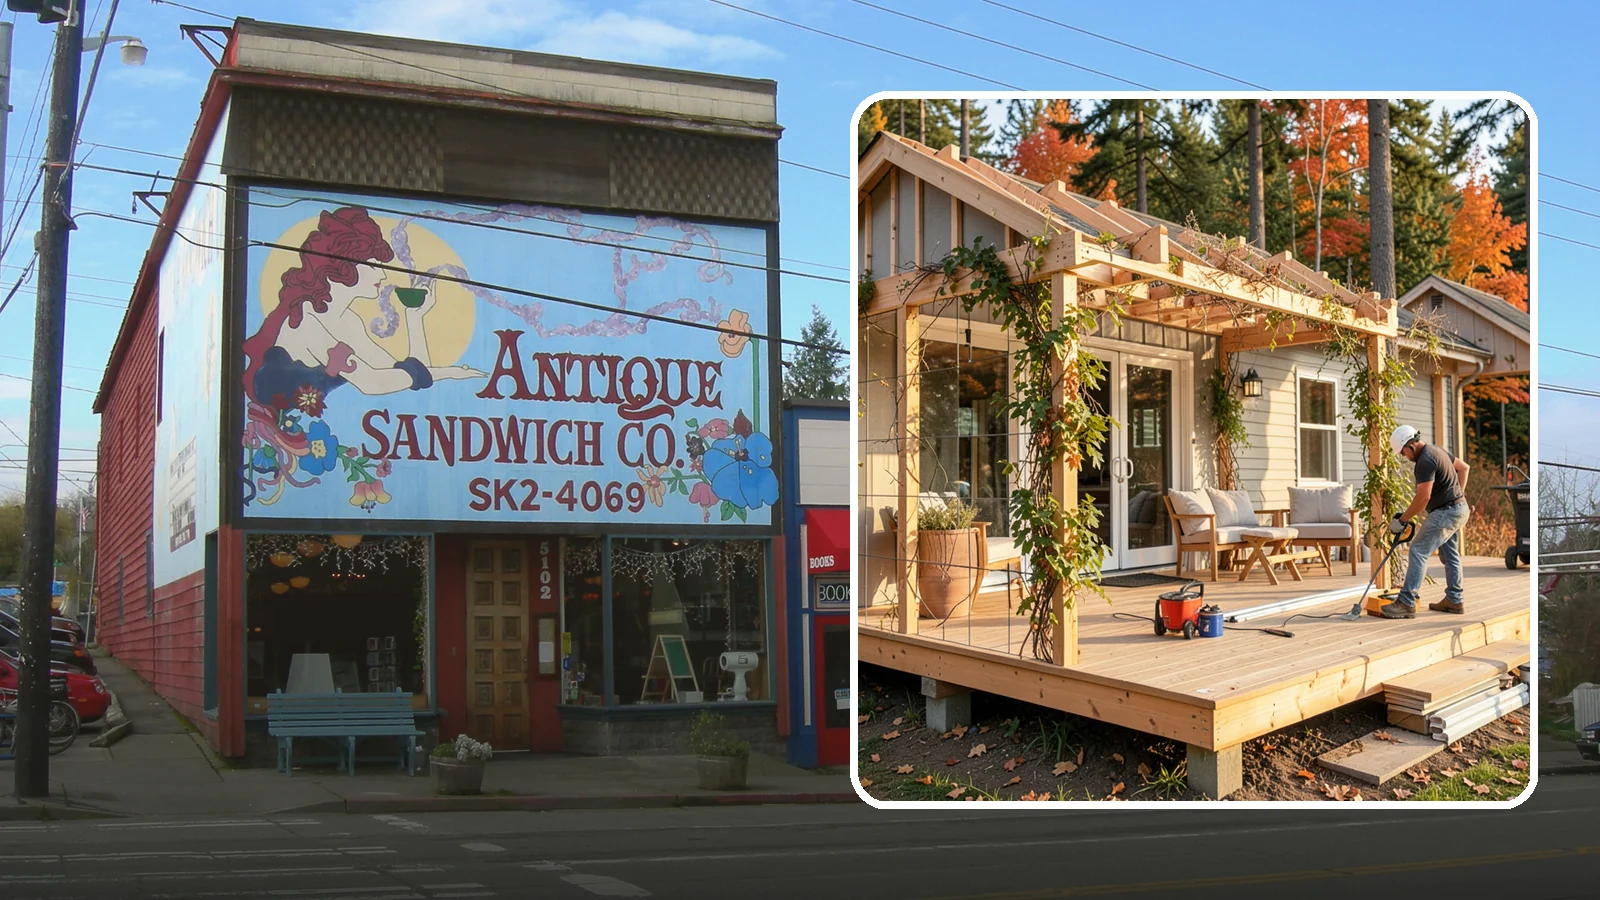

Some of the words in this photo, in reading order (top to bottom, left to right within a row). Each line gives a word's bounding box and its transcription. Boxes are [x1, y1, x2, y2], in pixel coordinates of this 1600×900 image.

[475, 328, 723, 420] ANTIQUE
[361, 408, 604, 468] SANDWICH
[616, 421, 685, 469] CO.
[468, 477, 645, 513] SK2-4069
[539, 542, 552, 600] 5102
[809, 555, 835, 569] BOOKS
